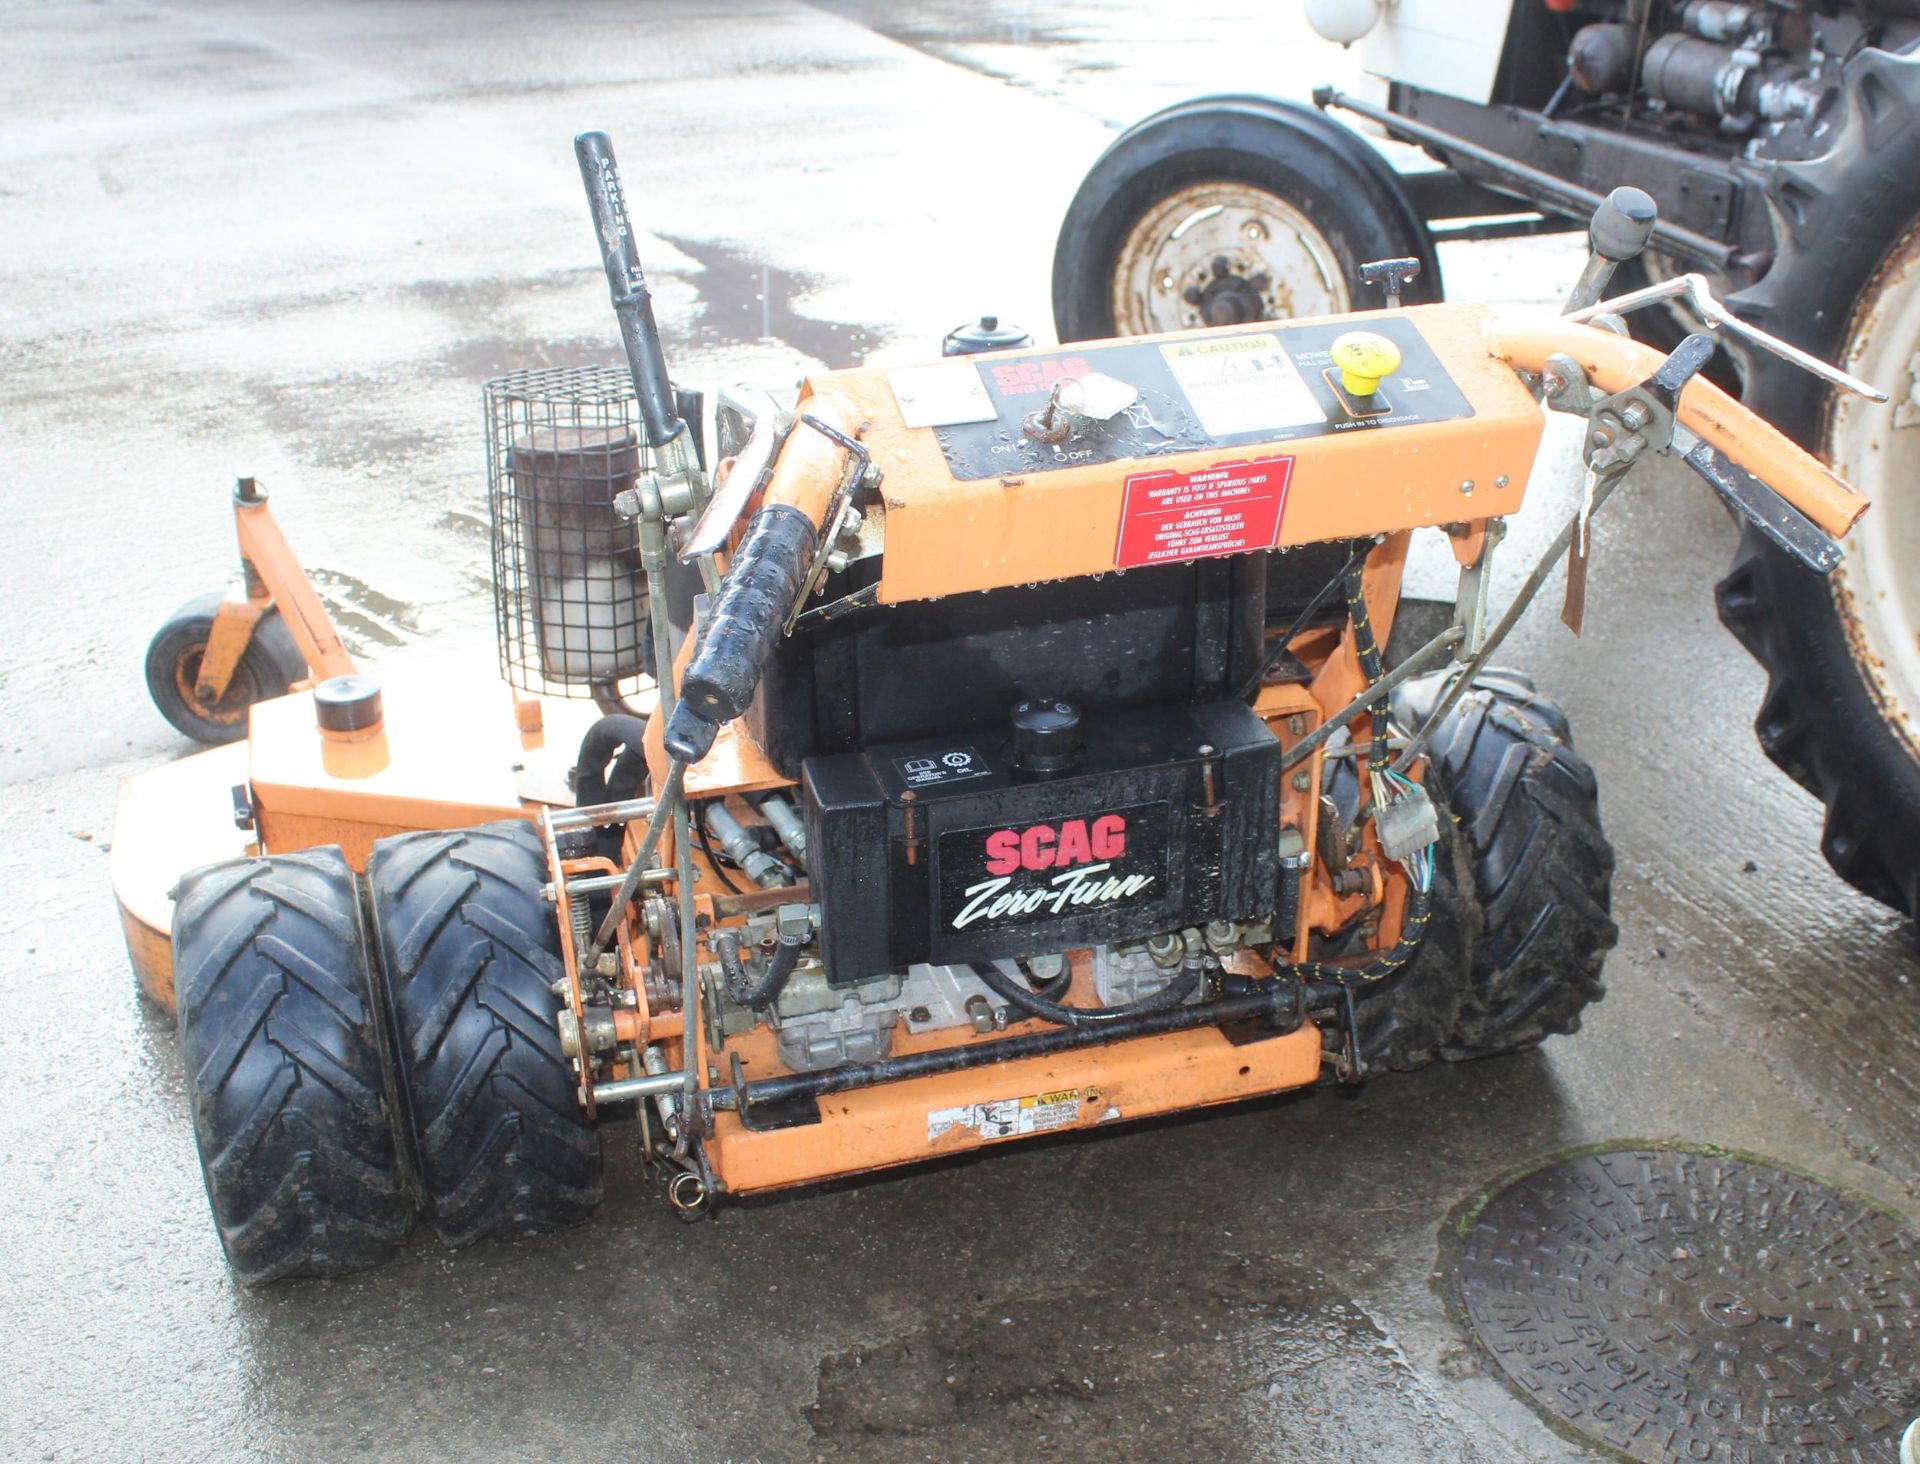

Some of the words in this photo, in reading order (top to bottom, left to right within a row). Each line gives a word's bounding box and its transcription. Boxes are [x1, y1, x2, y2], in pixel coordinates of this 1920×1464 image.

[601, 158, 627, 236] PARKING
[1196, 338, 1268, 355] CAUTION
[1294, 350, 1332, 361] MOWE
[992, 357, 1091, 387] SCAG
[1334, 421, 1355, 430] PUSH
[1356, 419, 1365, 427] IN
[1366, 418, 1377, 426] TO
[1377, 413, 1419, 425] DISENGAGE
[991, 445, 1010, 455] ON
[1068, 449, 1093, 460] OFF
[1148, 486, 1182, 498] WARRANTY
[1184, 485, 1189, 493] IS
[1191, 483, 1206, 492] VOID
[1208, 482, 1214, 490] IF
[1216, 479, 1246, 489] SPURIOUS
[1248, 475, 1267, 485] PARTS
[1161, 496, 1173, 505] ARE
[1175, 494, 1192, 503] USED
[1194, 493, 1203, 501] ON
[1206, 490, 1218, 499] THIS
[1220, 487, 1251, 497] MACHINE!
[1184, 508, 1222, 519] ACHTUNG!
[1161, 522, 1174, 532] DER
[1175, 518, 1207, 529] GEBRAUCH
[1209, 516, 1222, 524] VON
[1223, 513, 1242, 522] NICHT
[1189, 536, 1202, 545] ZUM
[1204, 532, 1230, 542] VERLUST
[1147, 547, 1179, 559] JEGLICHER
[985, 814, 1126, 876] SCAG
[952, 863, 1155, 930] Zero-Turn
